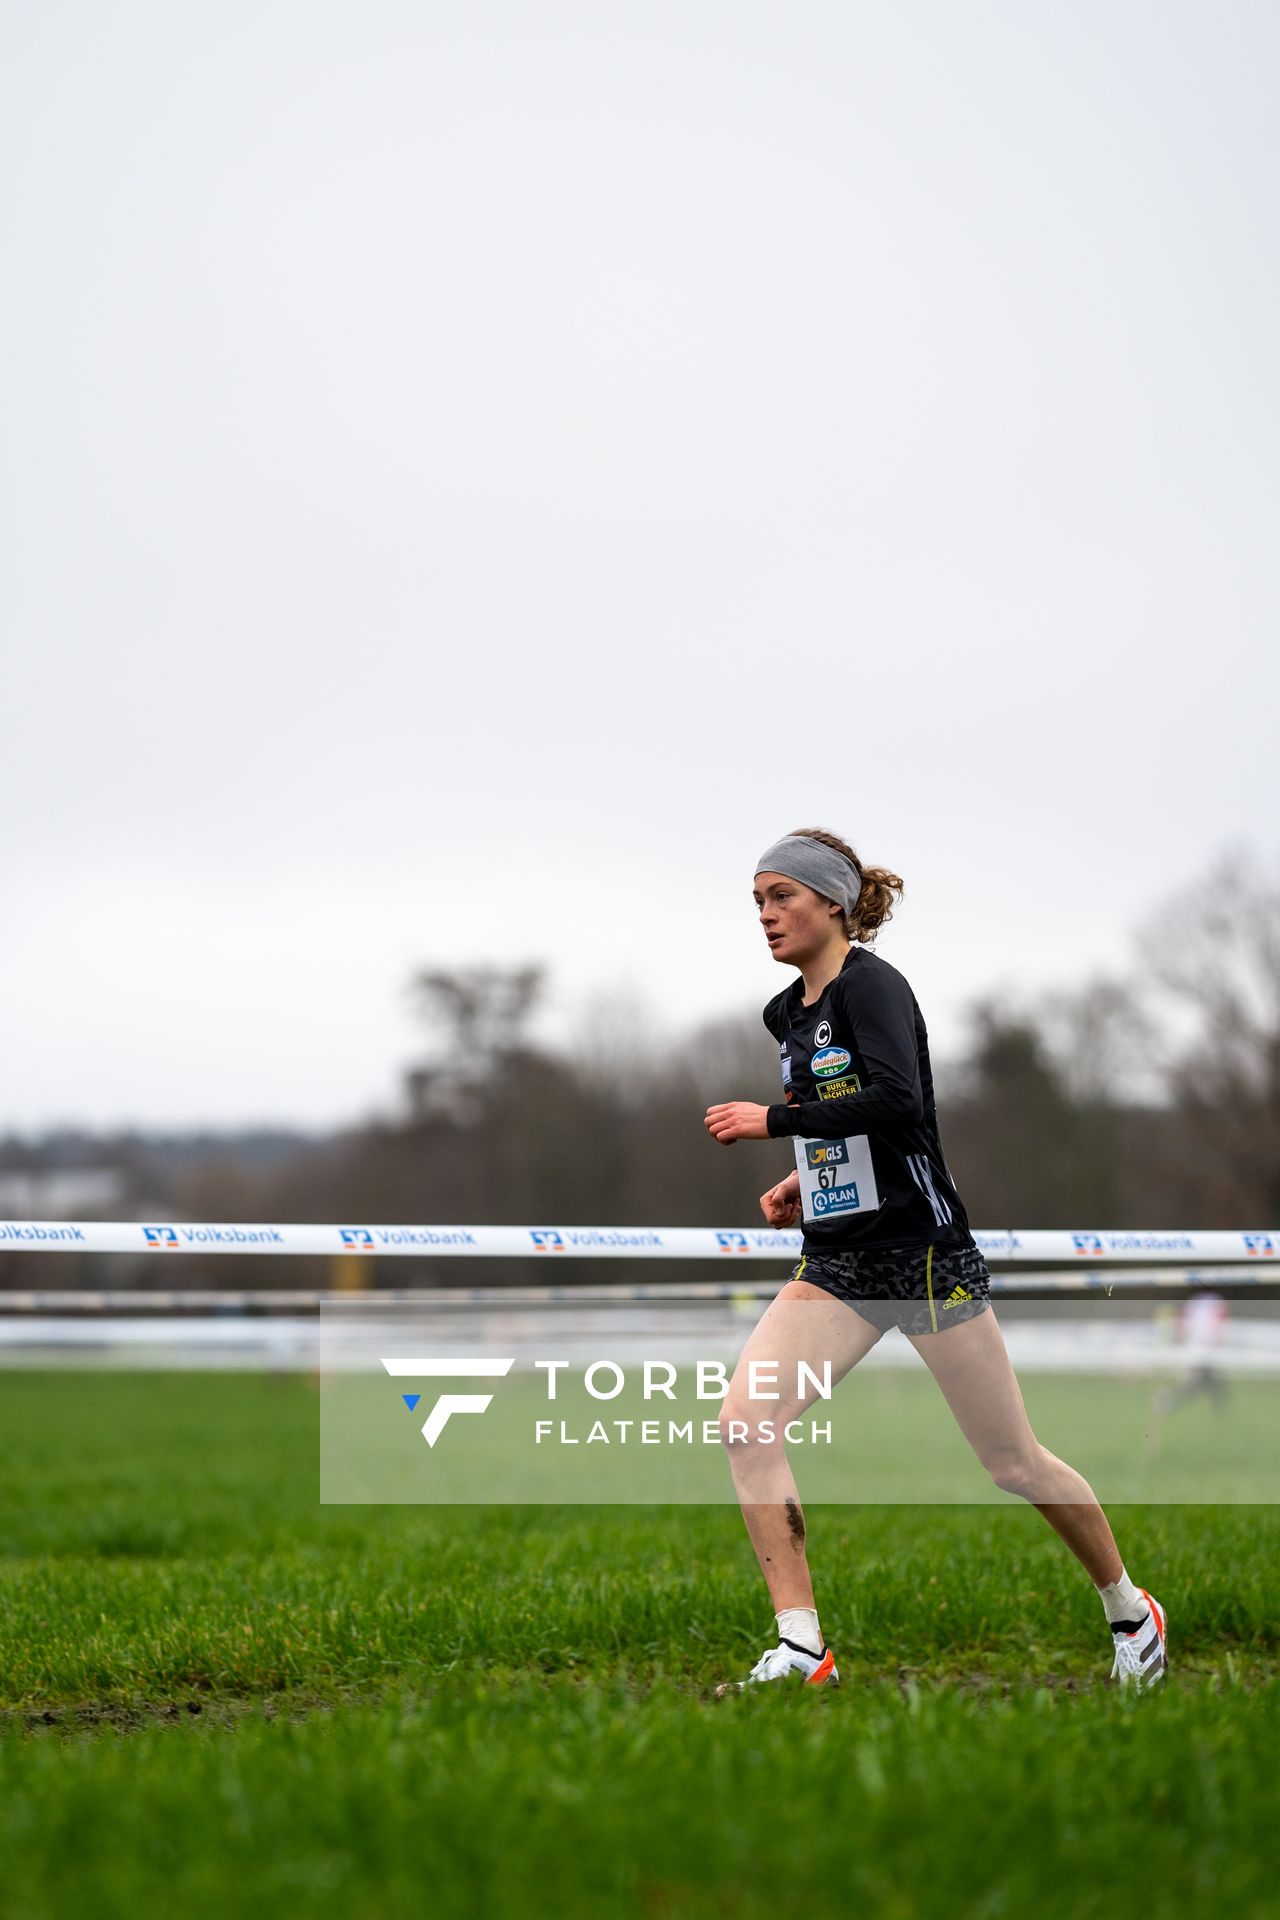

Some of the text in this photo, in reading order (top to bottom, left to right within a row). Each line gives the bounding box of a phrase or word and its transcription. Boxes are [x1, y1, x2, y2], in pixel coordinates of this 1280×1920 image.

[826, 1081, 847, 1092] BURG
[826, 1145, 842, 1160] GLS
[818, 1166, 837, 1189] 67
[828, 1188, 856, 1203] PLAN
[0, 1225, 86, 1241] olksbank
[180, 1227, 284, 1242] Volksbank
[375, 1229, 476, 1244] Volksbank
[564, 1231, 664, 1247] Volksbank
[750, 1232, 802, 1247] Volks
[1106, 1234, 1193, 1249] Volksbank
[942, 1293, 973, 1310] adidas
